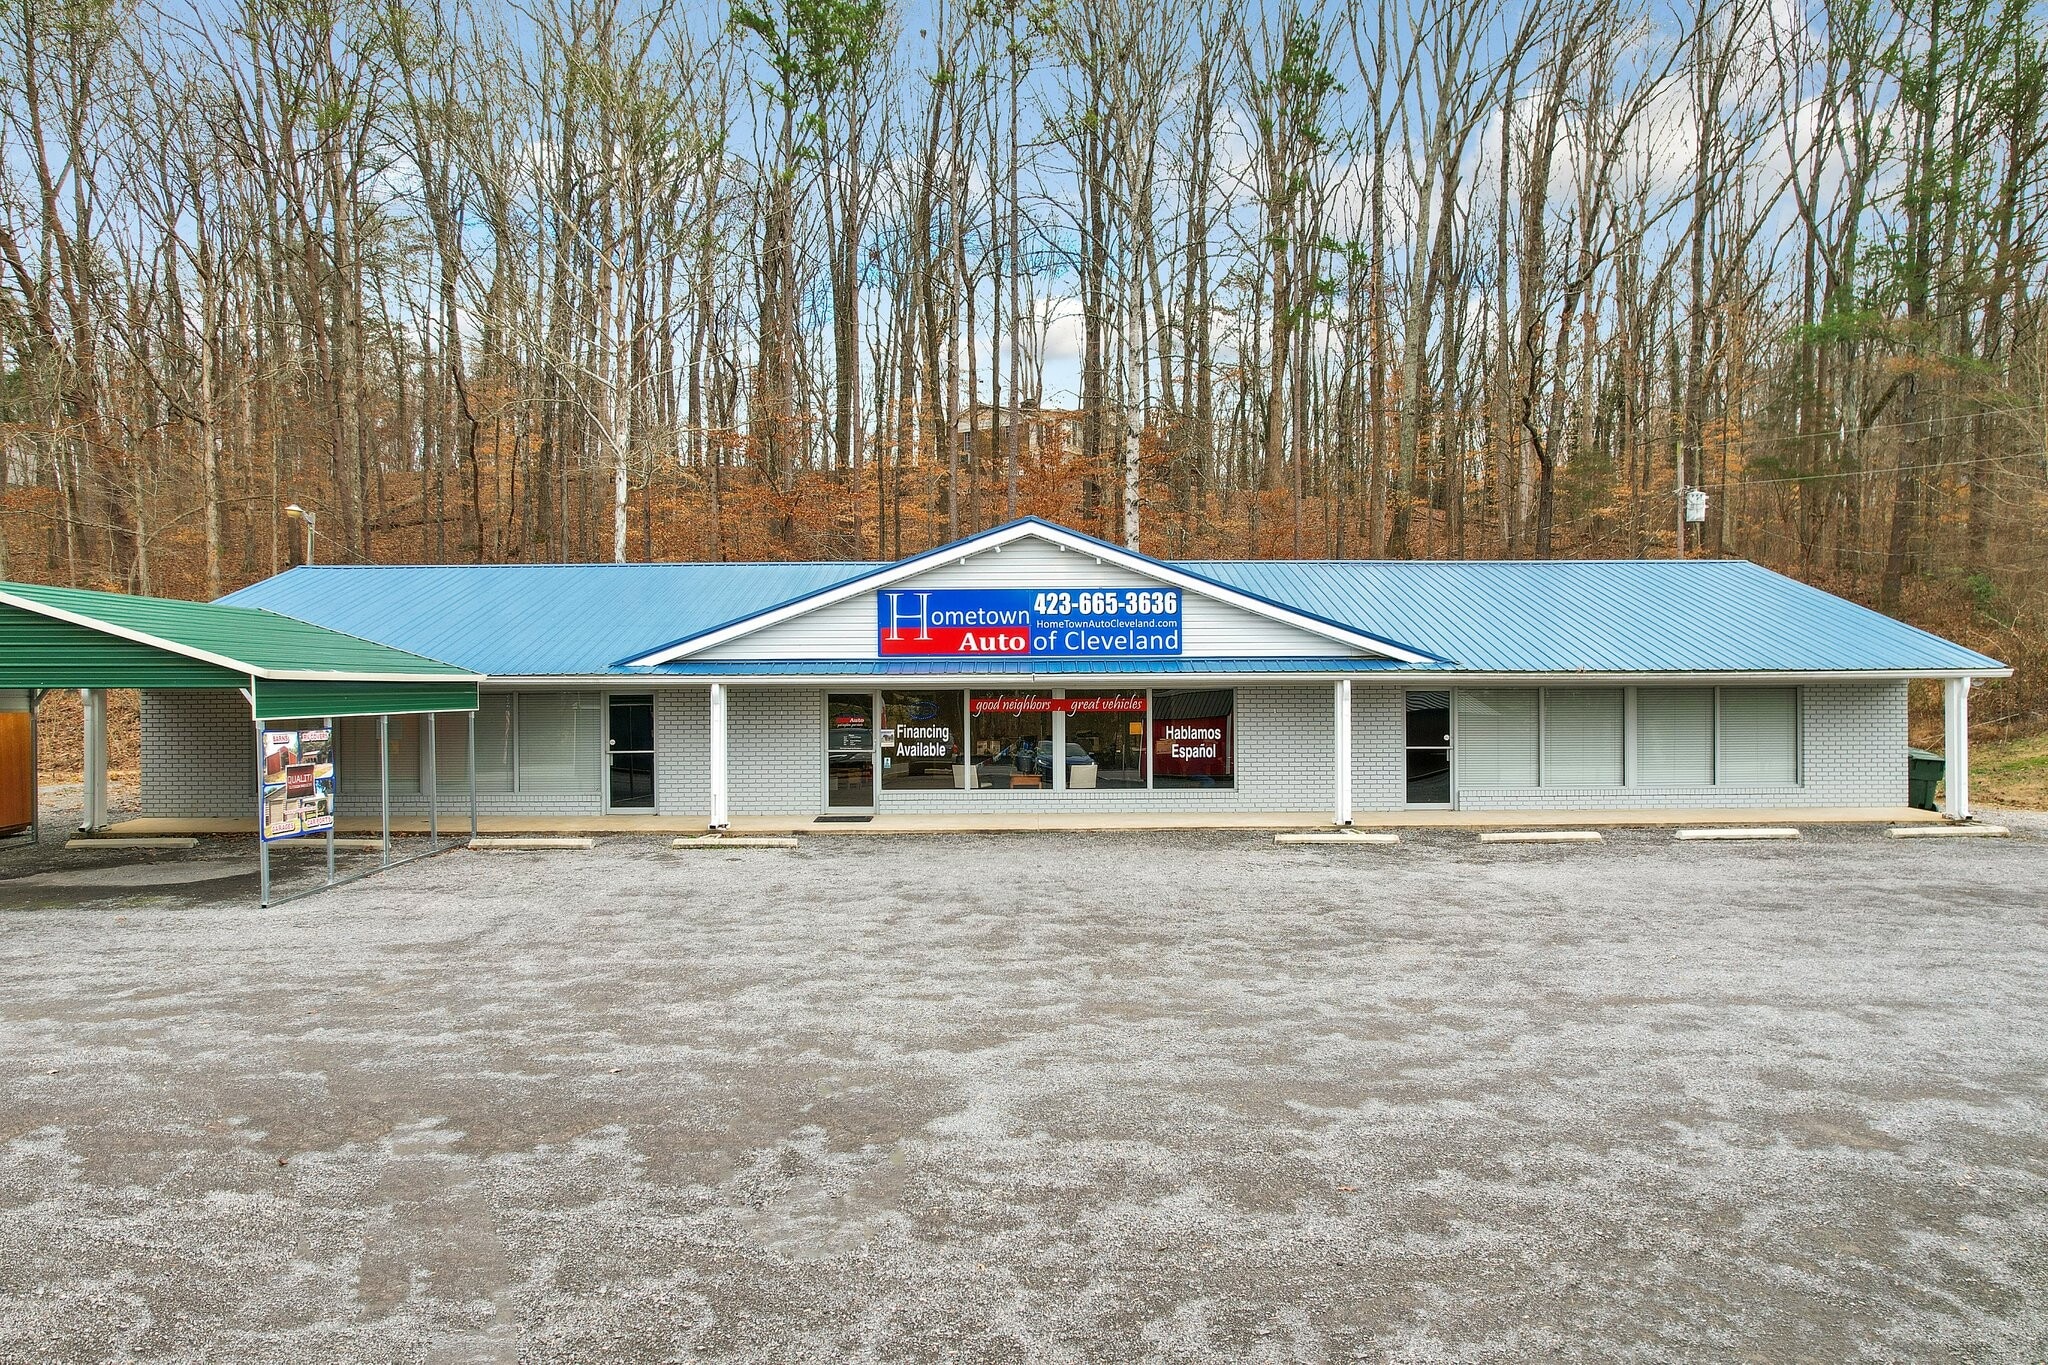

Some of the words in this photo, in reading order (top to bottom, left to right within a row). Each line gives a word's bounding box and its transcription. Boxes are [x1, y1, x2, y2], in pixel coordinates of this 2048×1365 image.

[1033, 592, 1177, 615] 423-665-3636
[885, 593, 1030, 641] Hometown
[1036, 619, 1178, 629] HomeTownAutoCleveland.com
[958, 632, 1026, 651] Auto
[1033, 630, 1058, 650] of
[1064, 629, 1179, 650] Cleveland
[972, 694, 1003, 717] good
[1002, 694, 1052, 717] neighbors
[1067, 696, 1100, 717] great
[1102, 694, 1143, 710] vehicles
[897, 724, 950, 742] Financing
[1165, 725, 1222, 740] Hablamos
[896, 742, 946, 757] Available
[1171, 743, 1216, 762] Español
